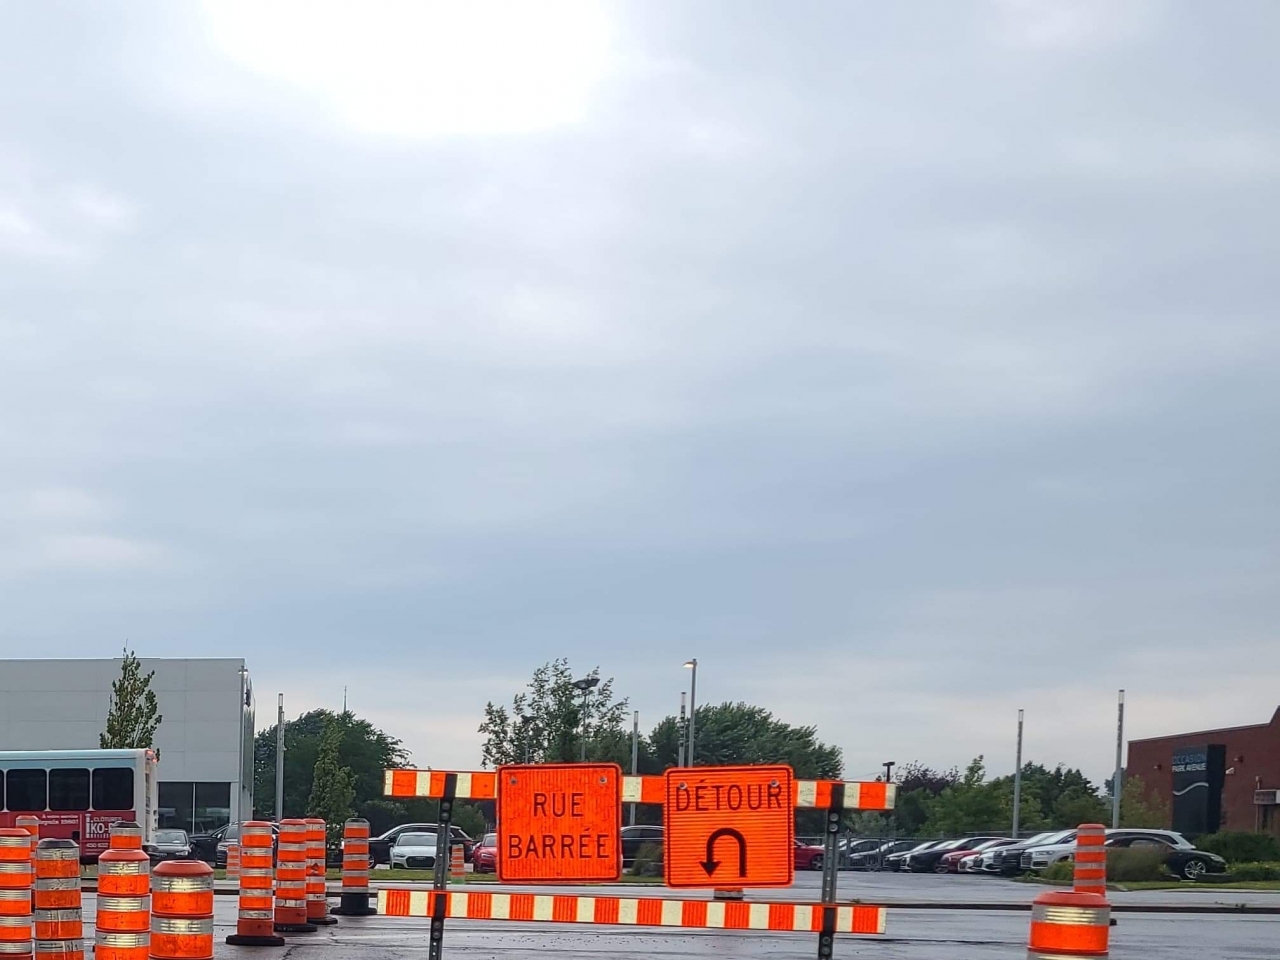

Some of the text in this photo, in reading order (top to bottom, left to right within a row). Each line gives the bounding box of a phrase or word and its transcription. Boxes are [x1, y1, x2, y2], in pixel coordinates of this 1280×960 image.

[533, 792, 584, 818] RUE
[675, 778, 783, 812] DÉTOUR
[508, 826, 610, 860] BARRÉE
